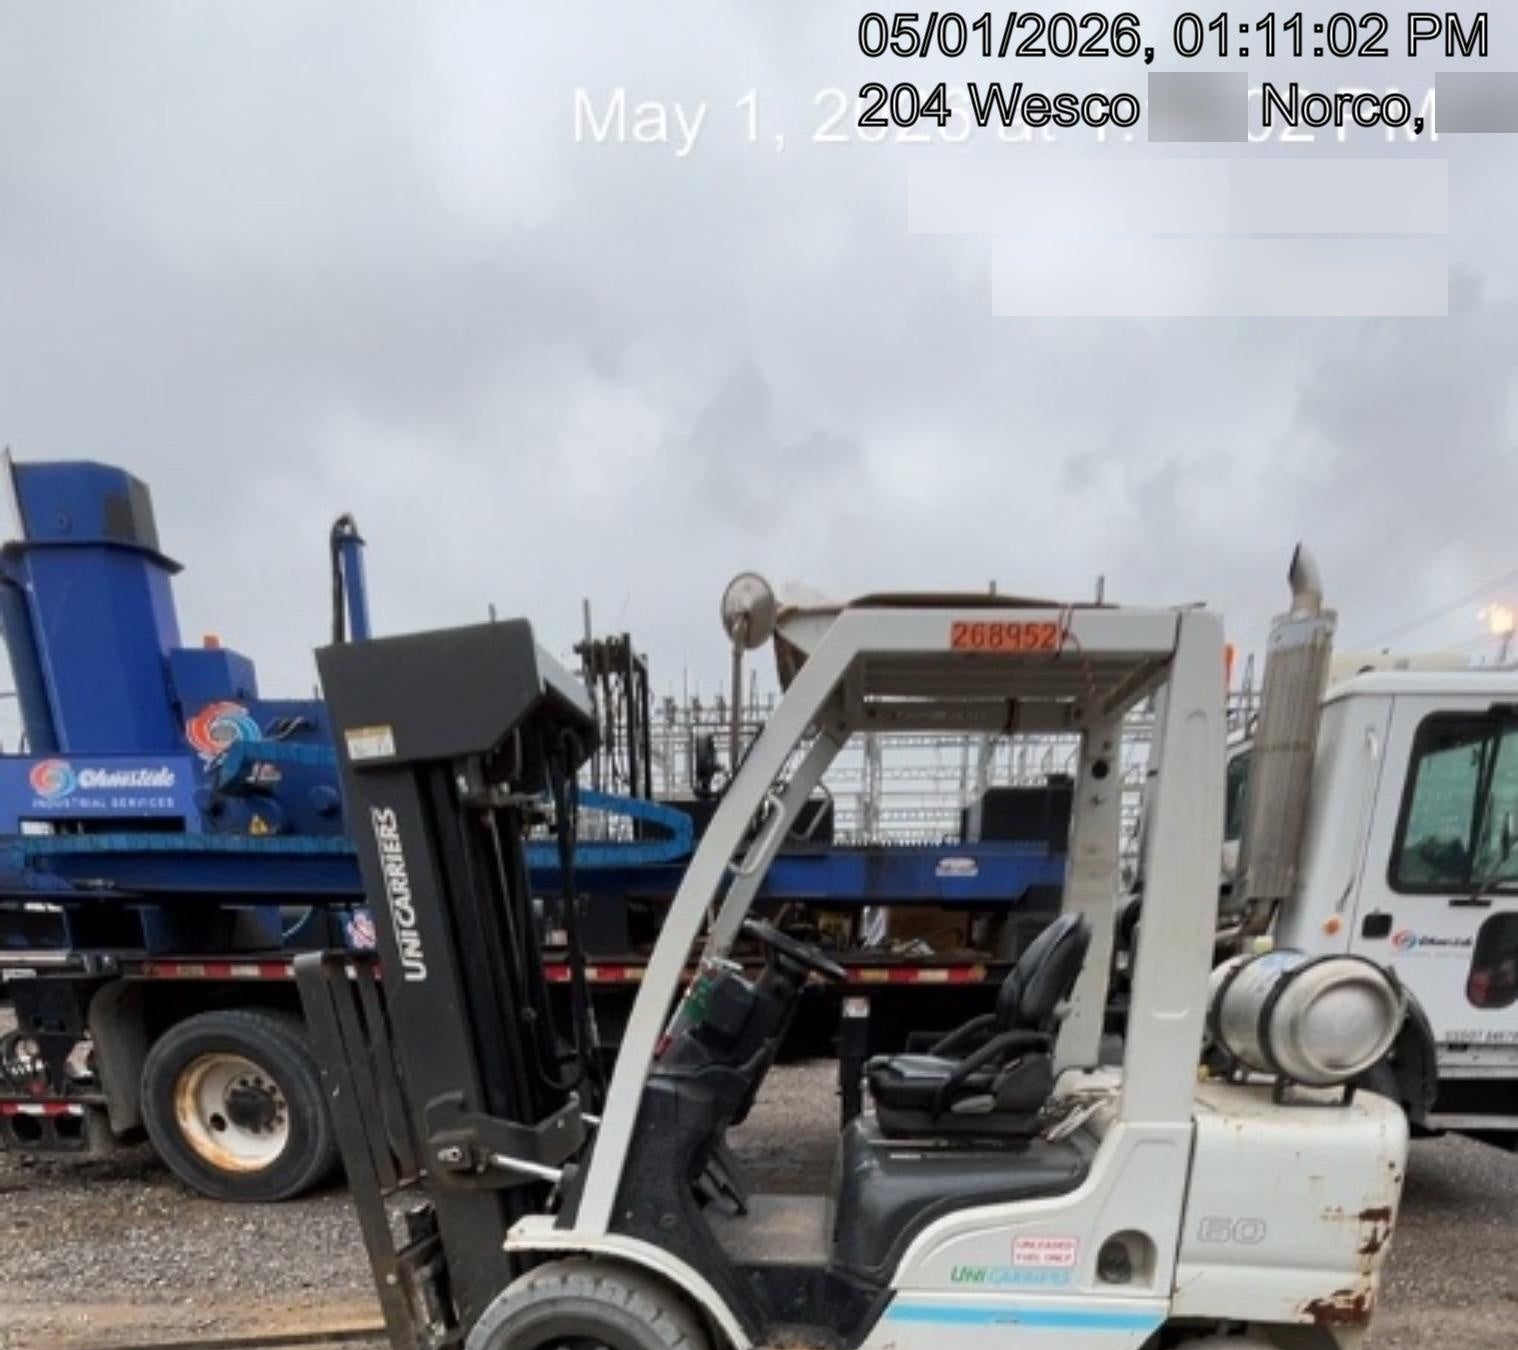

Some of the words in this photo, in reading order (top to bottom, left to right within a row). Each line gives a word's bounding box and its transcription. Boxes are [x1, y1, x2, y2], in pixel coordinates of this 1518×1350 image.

[952, 622, 1058, 650] 268952
[32, 797, 106, 809] INDUSTRIAL
[111, 797, 175, 809] SERVICES
[370, 806, 428, 983] UNICARRIERS
